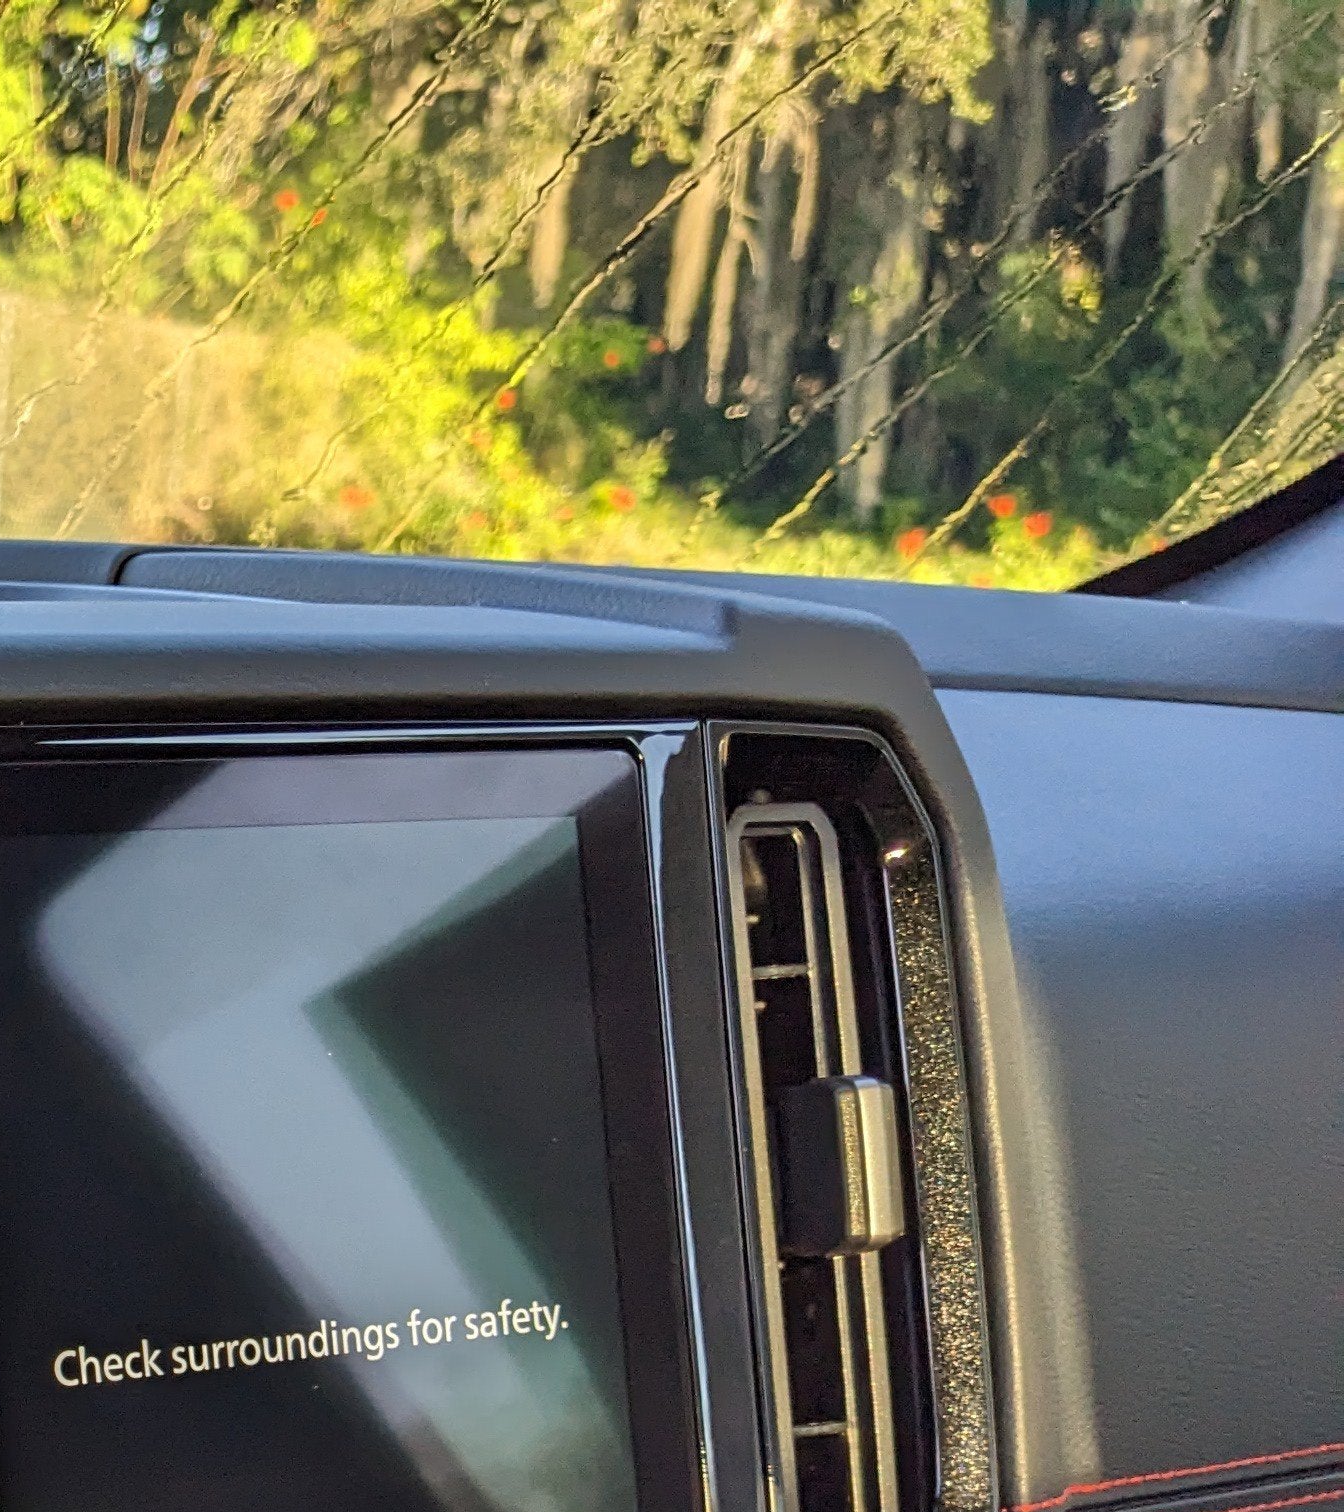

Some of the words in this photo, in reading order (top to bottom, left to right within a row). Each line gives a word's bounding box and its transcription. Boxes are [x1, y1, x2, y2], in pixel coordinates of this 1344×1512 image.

[53, 1339, 164, 1387] Check
[172, 1319, 399, 1376] surroundings
[407, 1308, 457, 1346] for
[464, 1298, 569, 1341] safety.
